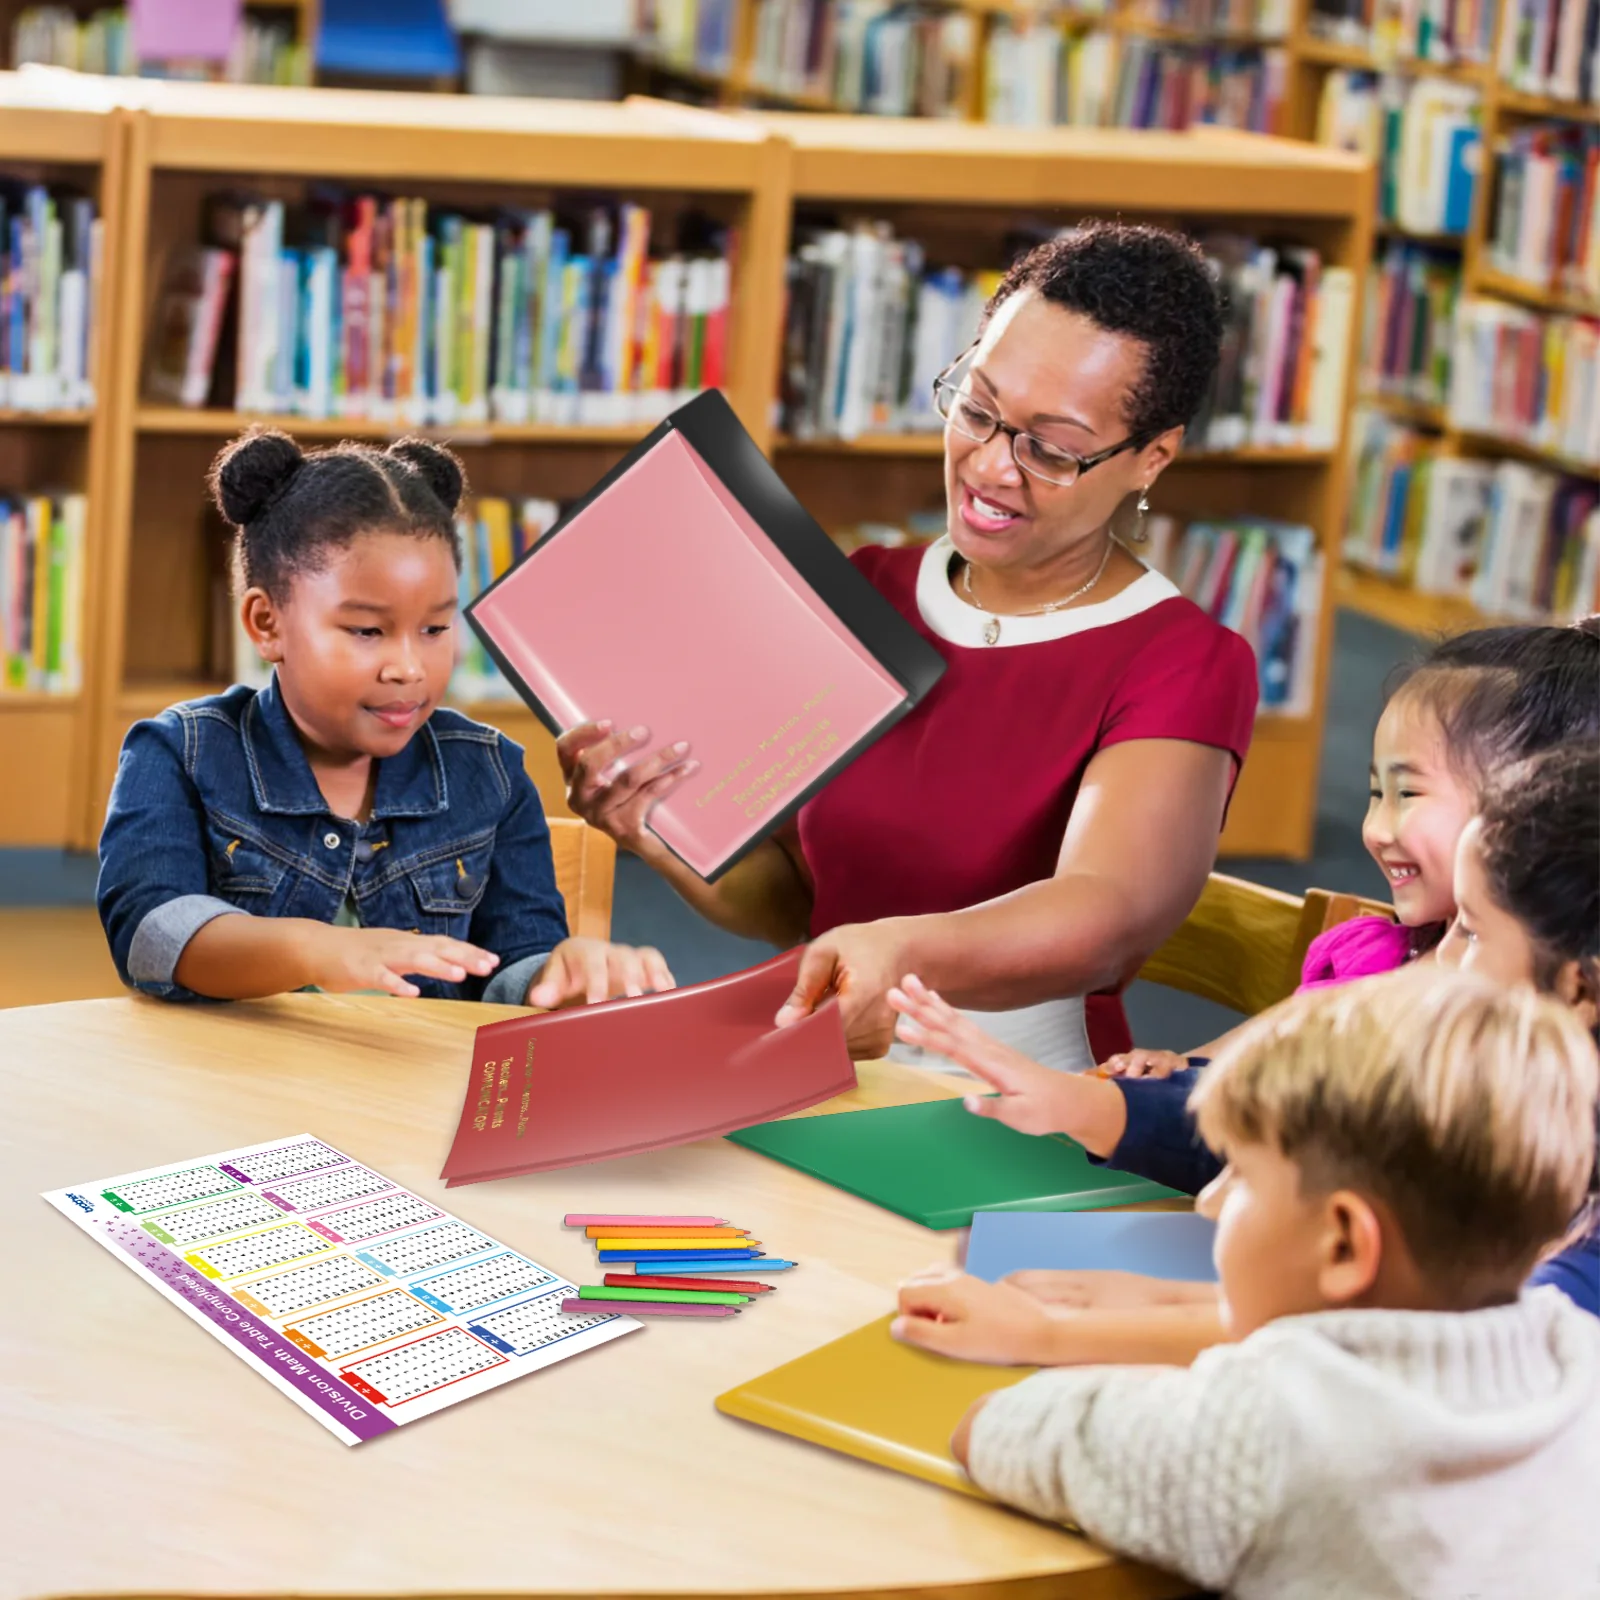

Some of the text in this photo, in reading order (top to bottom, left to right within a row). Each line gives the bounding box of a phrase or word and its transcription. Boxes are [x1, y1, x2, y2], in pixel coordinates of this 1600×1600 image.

[175, 1274, 241, 1322] Completed
[239, 1320, 275, 1349] Table
[273, 1348, 309, 1376] Math
[307, 1373, 367, 1420] Division
